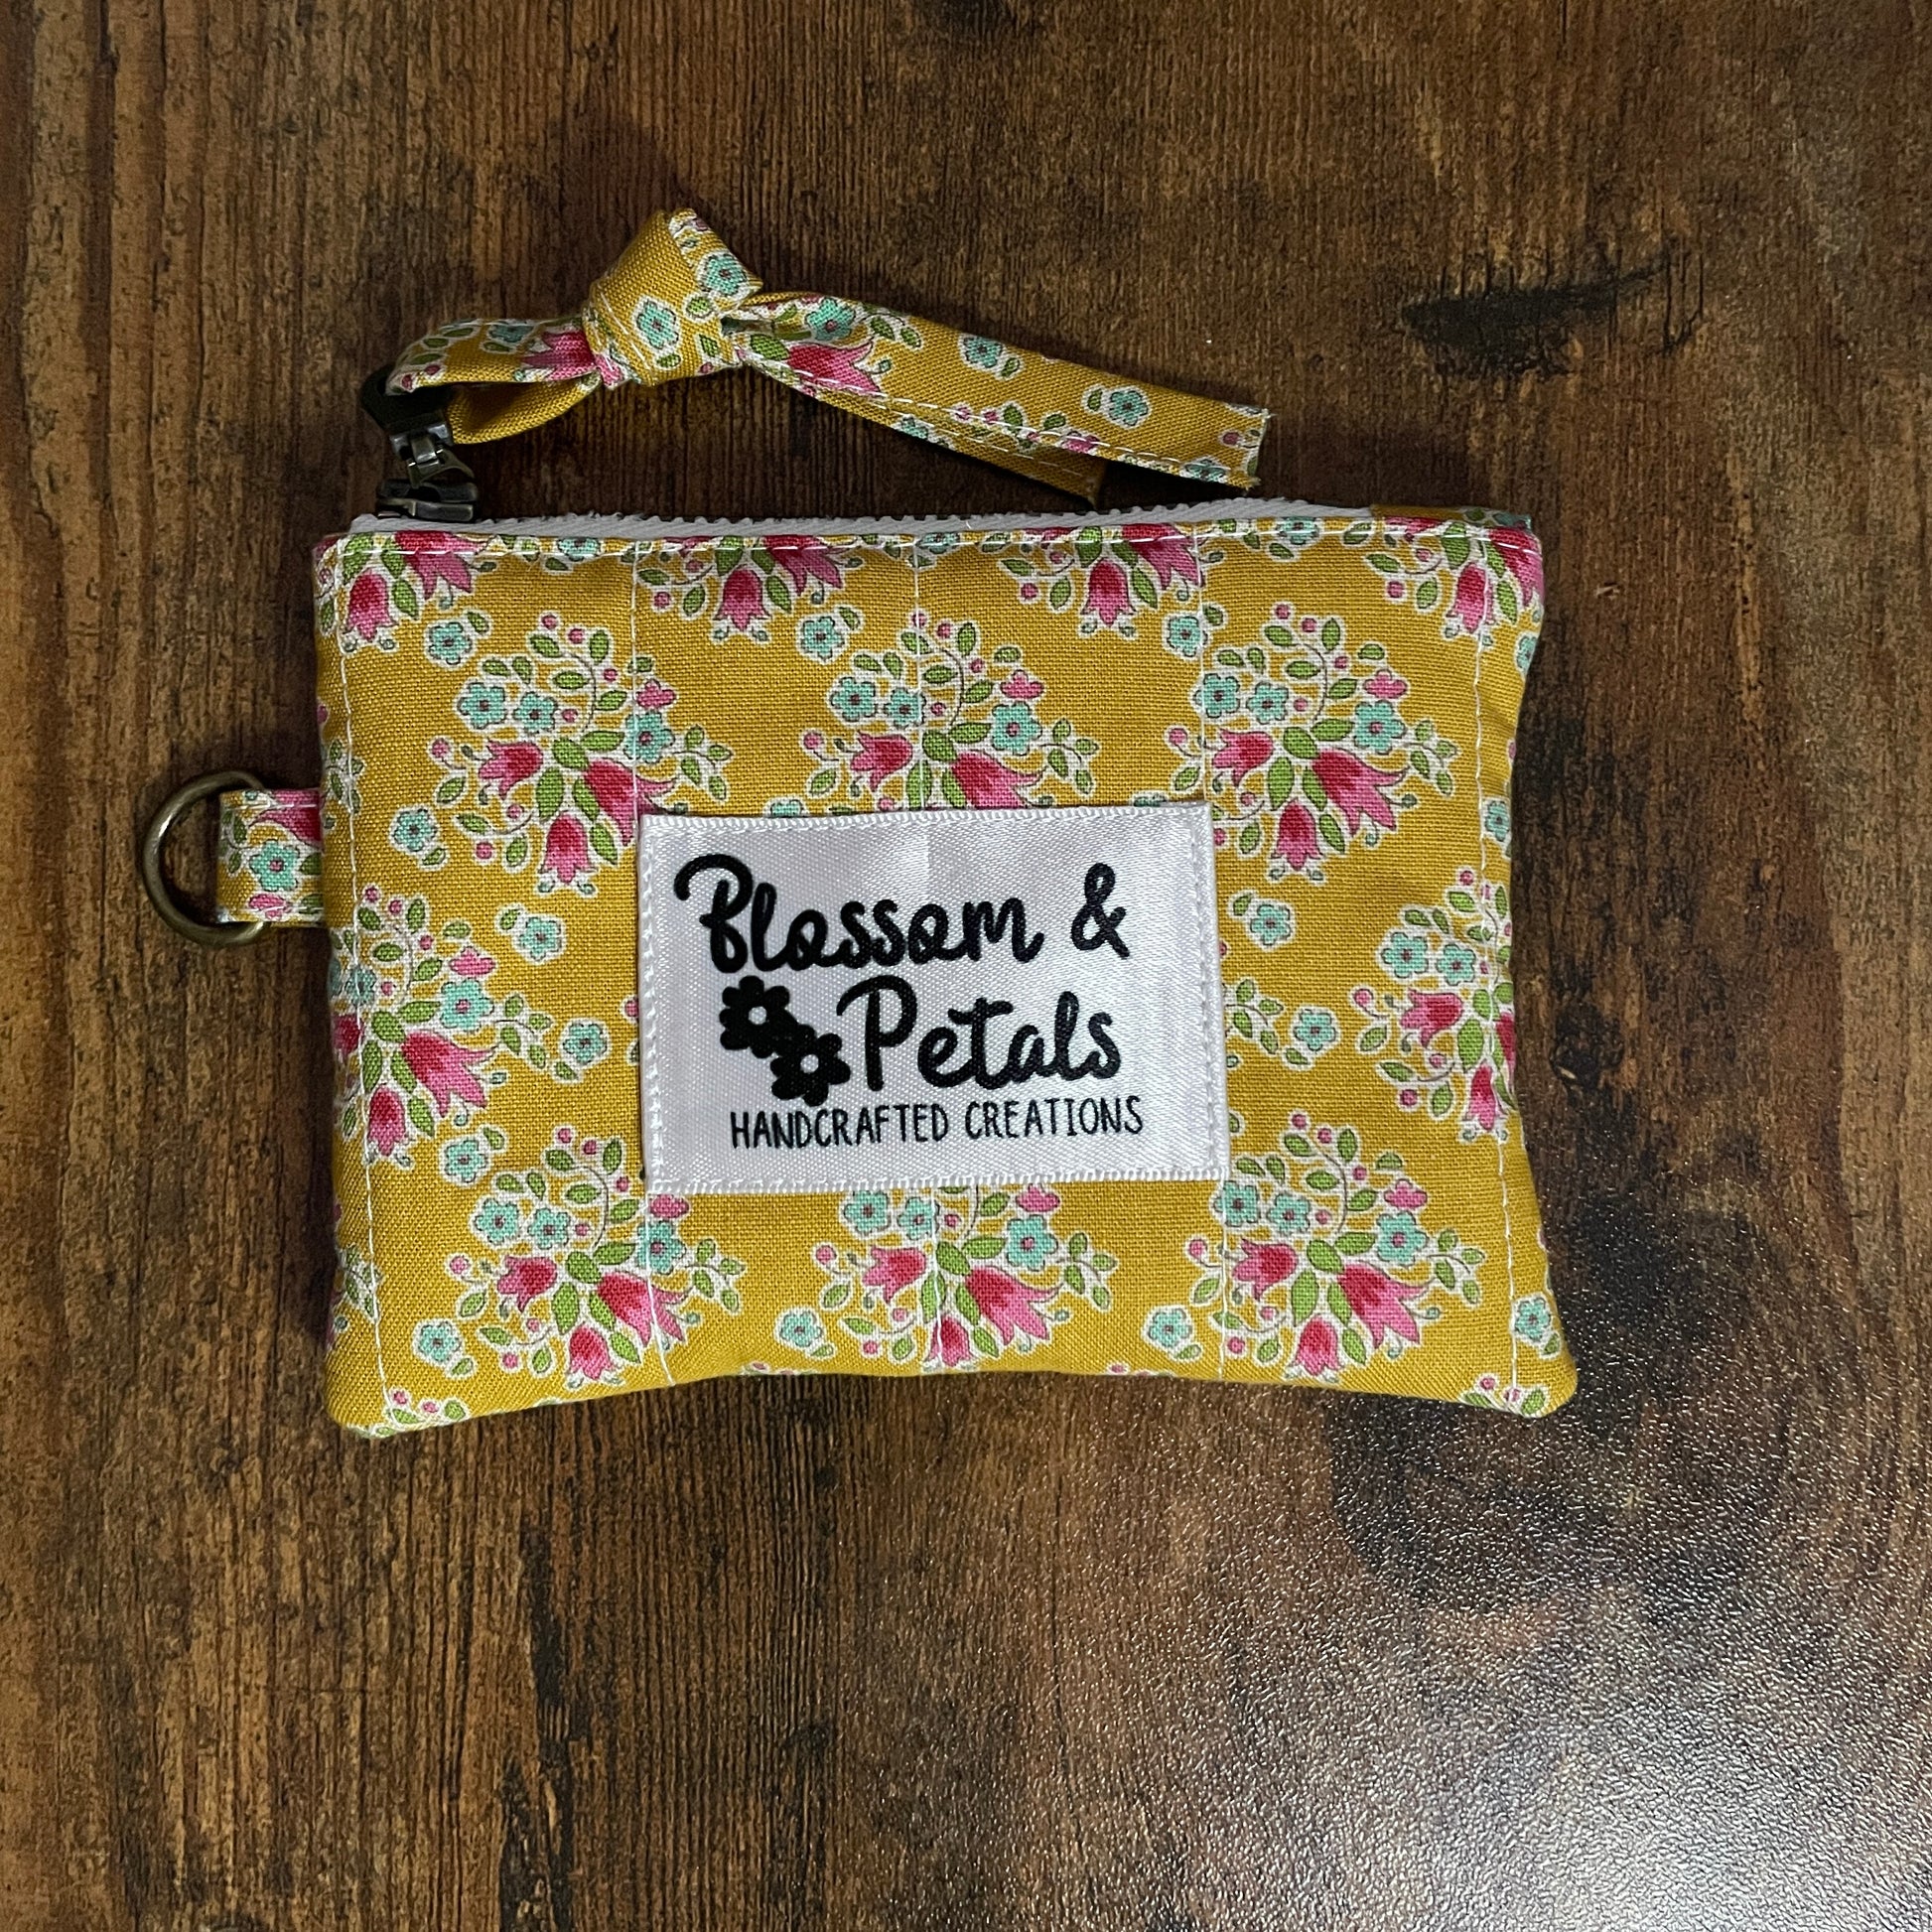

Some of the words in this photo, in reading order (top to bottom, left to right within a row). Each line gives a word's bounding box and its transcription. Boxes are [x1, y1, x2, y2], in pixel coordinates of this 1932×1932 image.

[673, 853, 1044, 974] Blossom
[1069, 862, 1130, 960] &
[836, 974, 1122, 1092] Petals
[731, 1103, 949, 1150] HANDCRAFTED
[964, 1095, 1144, 1140] CREATIONS
